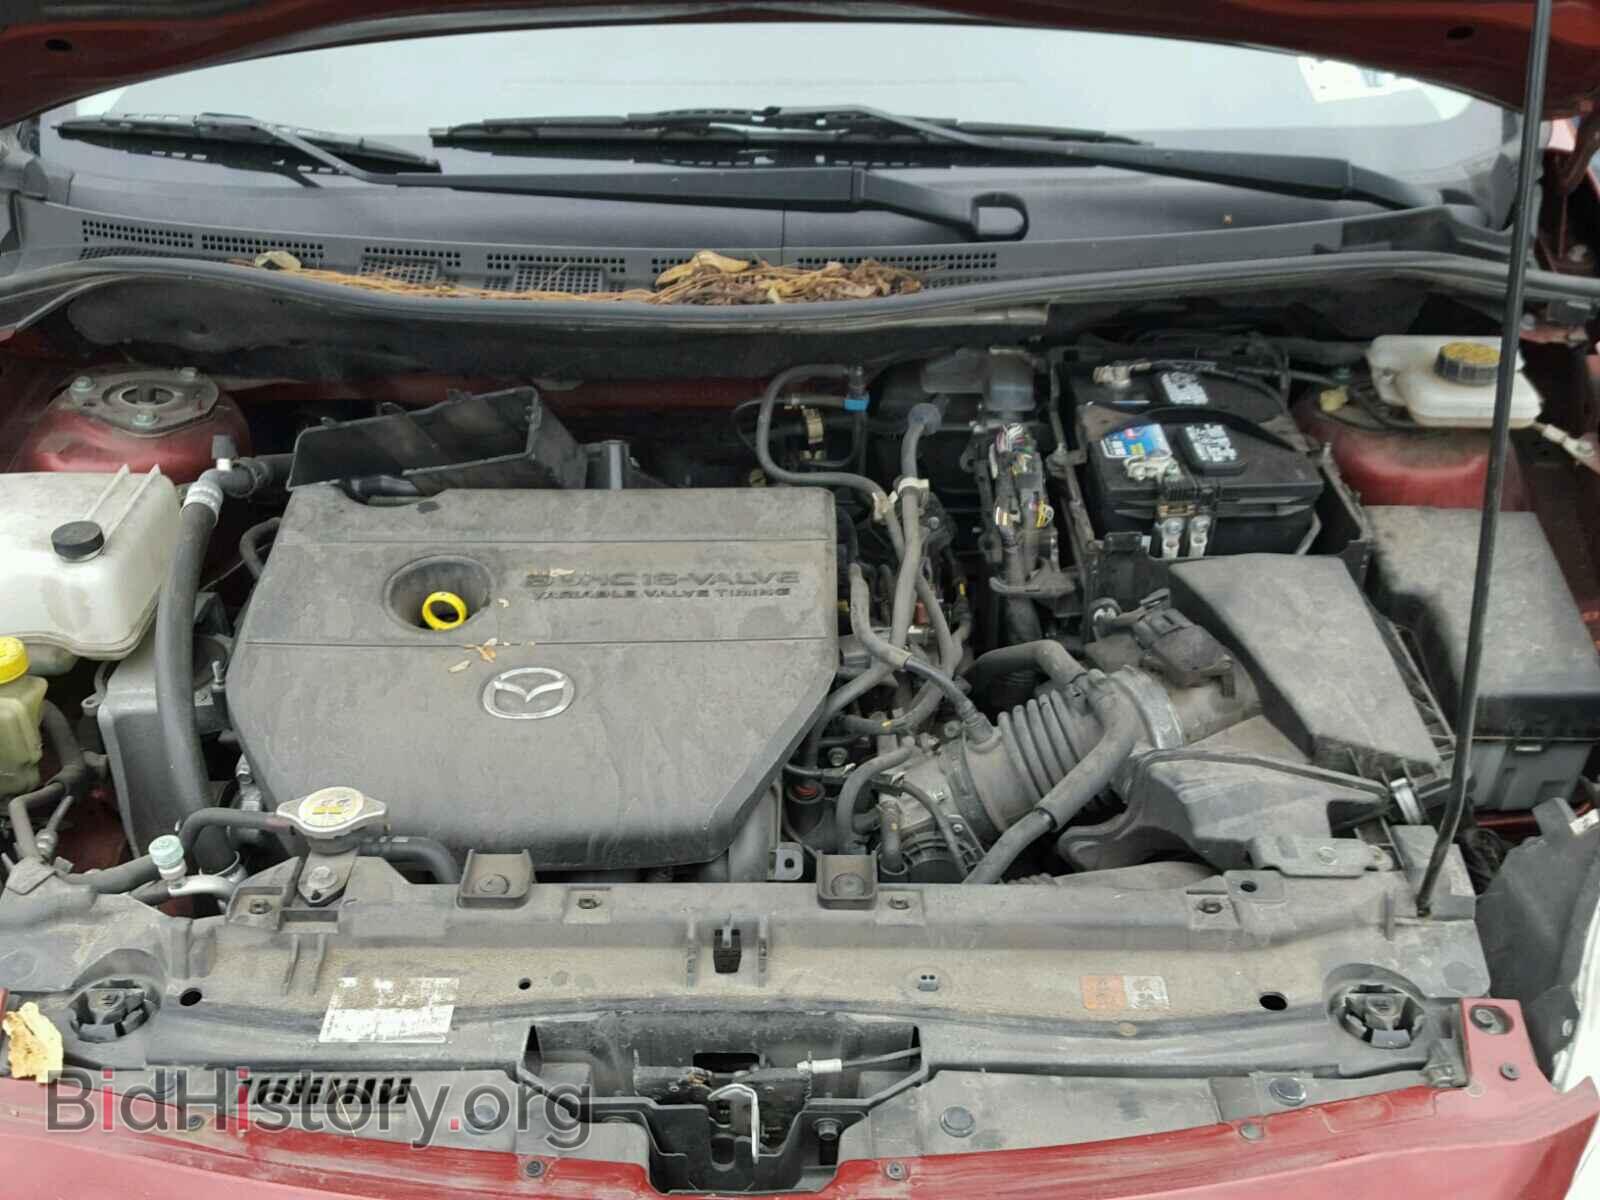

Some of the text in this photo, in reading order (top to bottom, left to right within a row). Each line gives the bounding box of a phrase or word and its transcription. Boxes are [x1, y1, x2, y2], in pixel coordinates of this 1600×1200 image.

[642, 570, 800, 585] 16-VALVE
[533, 587, 791, 600] VARIABLE VALVE TIMING
